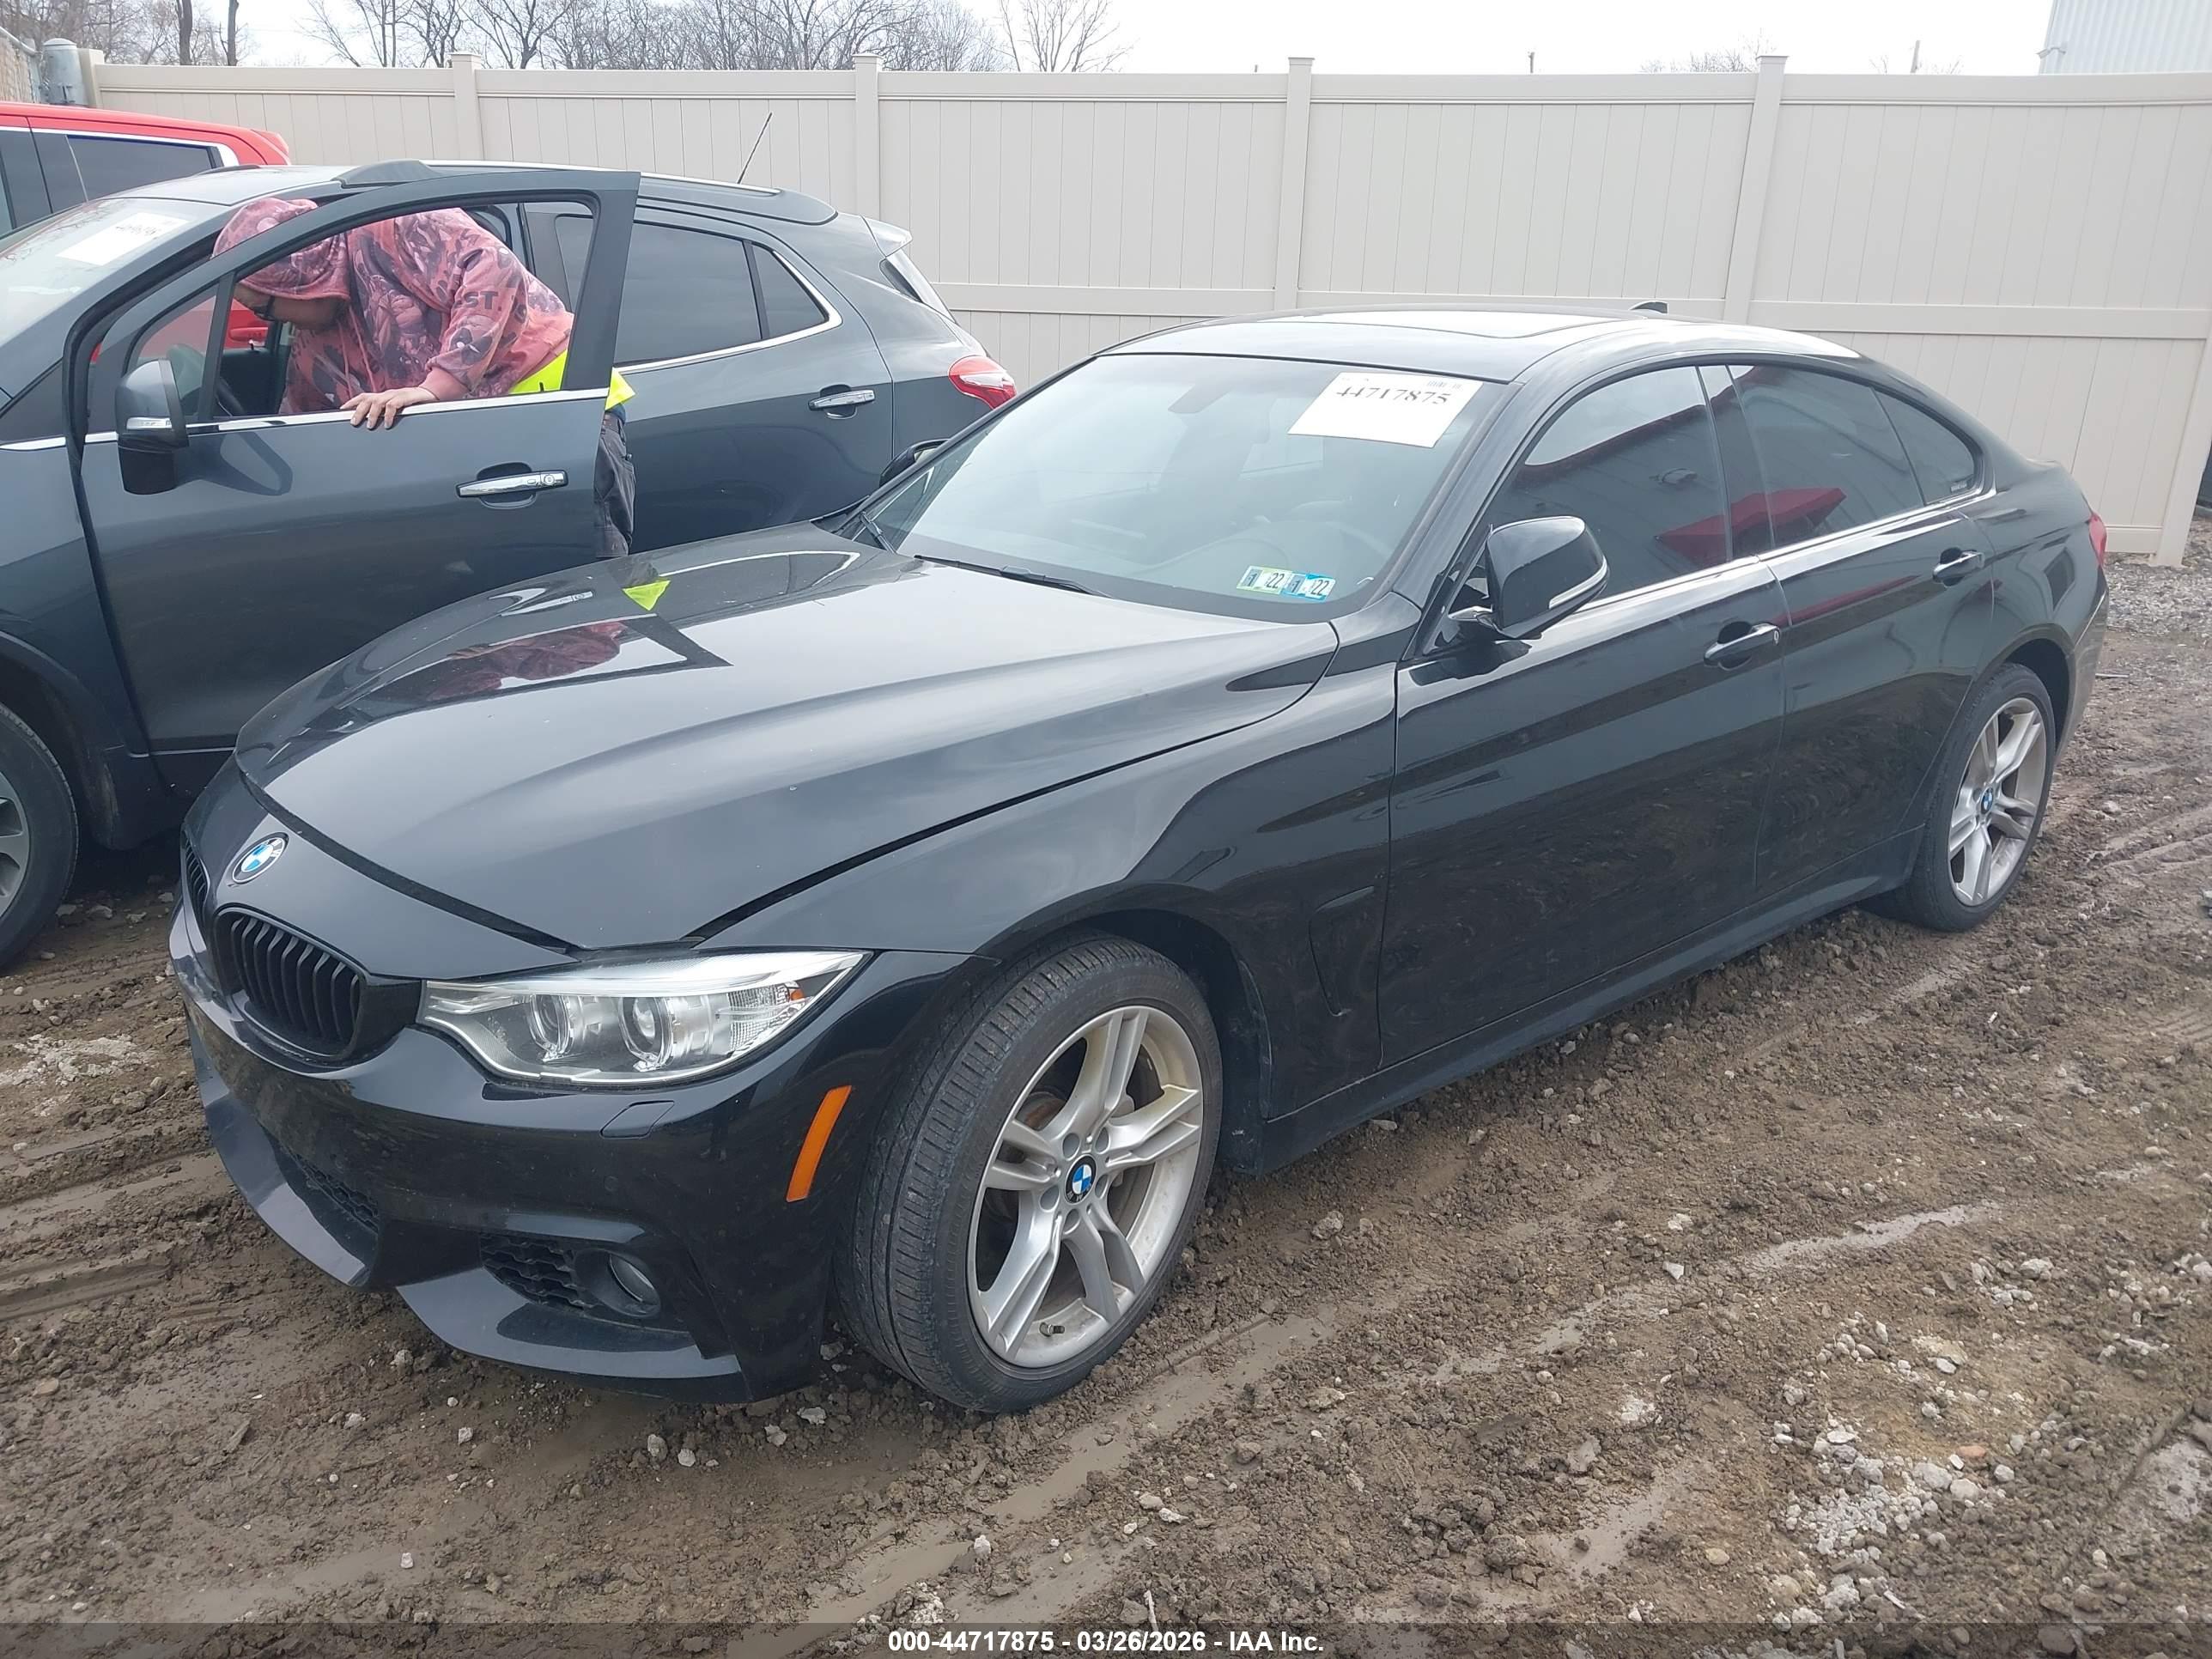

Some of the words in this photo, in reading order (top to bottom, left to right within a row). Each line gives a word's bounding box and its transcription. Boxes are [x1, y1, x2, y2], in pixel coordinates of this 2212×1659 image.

[1336, 386, 1451, 404] 44717875
[1266, 572, 1285, 589] 22
[1310, 579, 1330, 596] 22
